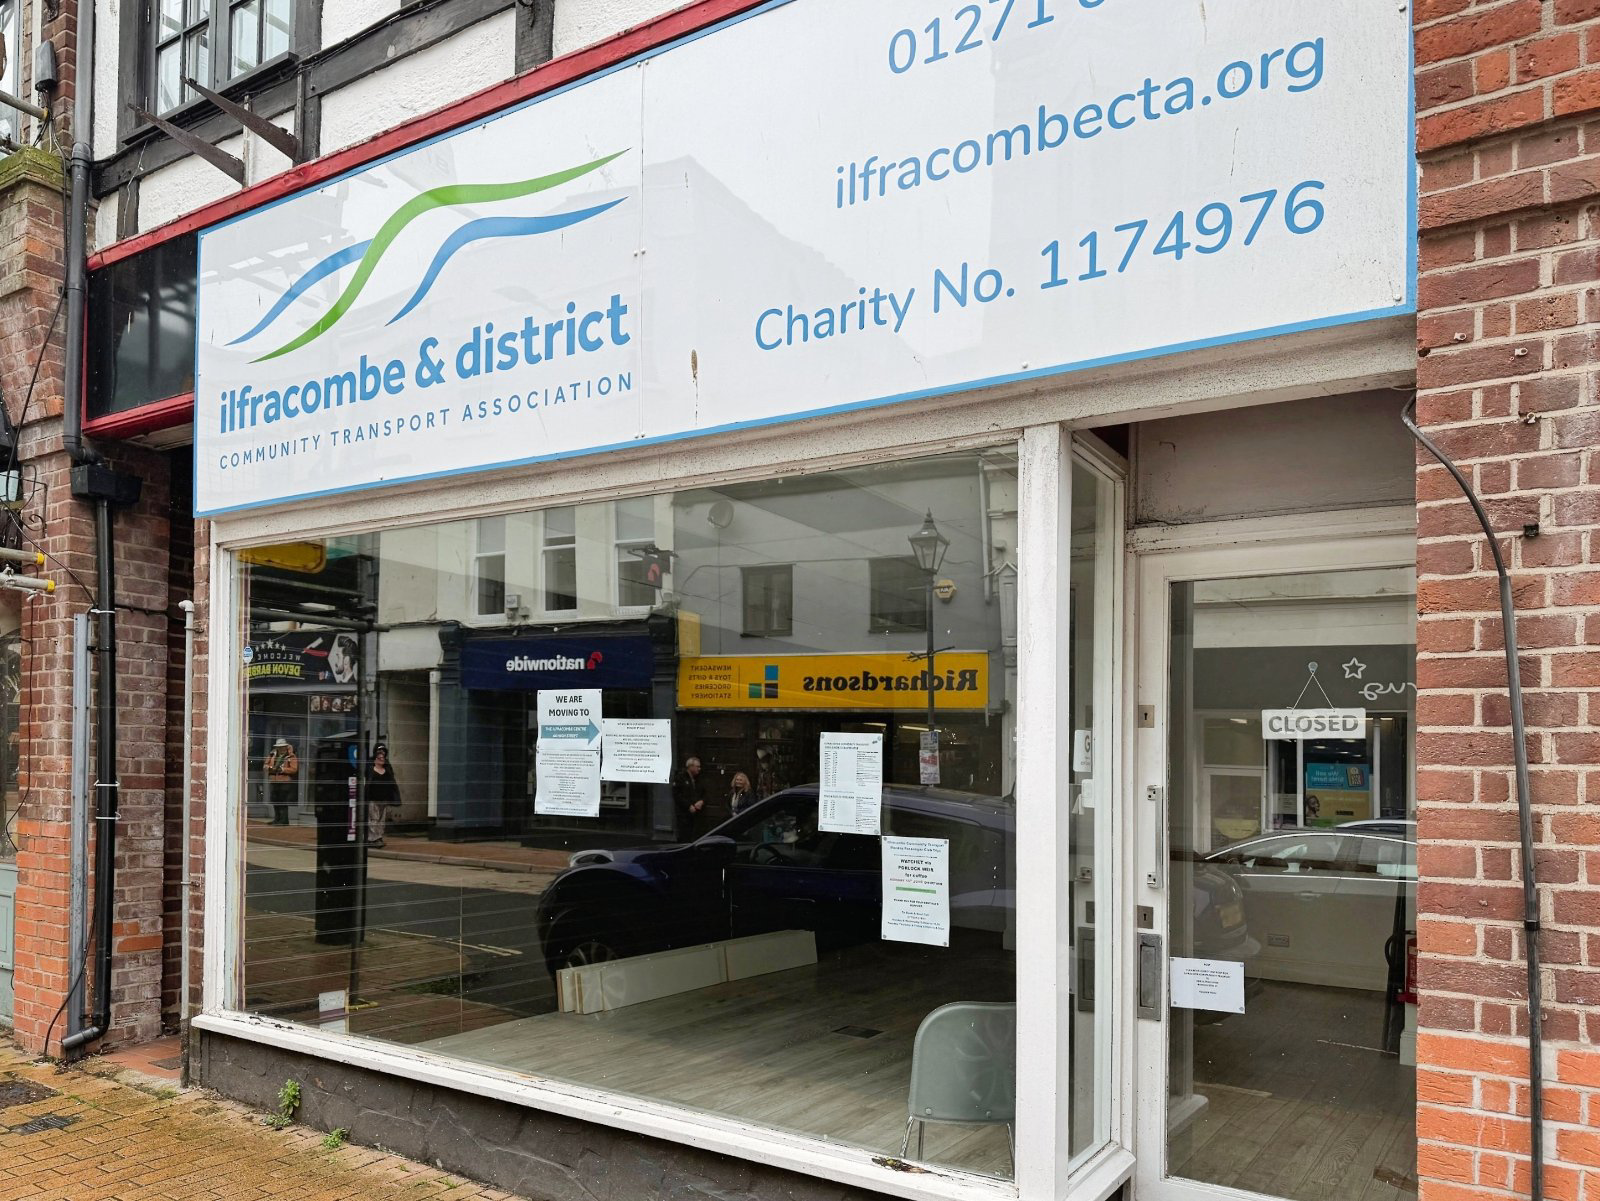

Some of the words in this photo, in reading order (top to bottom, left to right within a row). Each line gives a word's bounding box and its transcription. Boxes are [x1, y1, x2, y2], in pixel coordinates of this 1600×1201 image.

[889, 0, 1055, 74] 01271
[836, 37, 1325, 209] ilfracombecta.org
[755, 286, 915, 351] Charity
[933, 261, 1015, 314] No.
[1040, 179, 1325, 289] 1174976
[220, 355, 406, 434] ilfracombe
[415, 337, 446, 389] &
[455, 294, 631, 380] district
[220, 434, 321, 470] COMMUNITY
[331, 408, 450, 446] TRANSPORT
[462, 372, 632, 422] ASSOCIATION
[548, 708, 579, 717] MOVING
[580, 708, 590, 717] TO
[555, 695, 568, 703] WE
[569, 695, 583, 703] ARE
[1268, 715, 1359, 733] CLOSED
